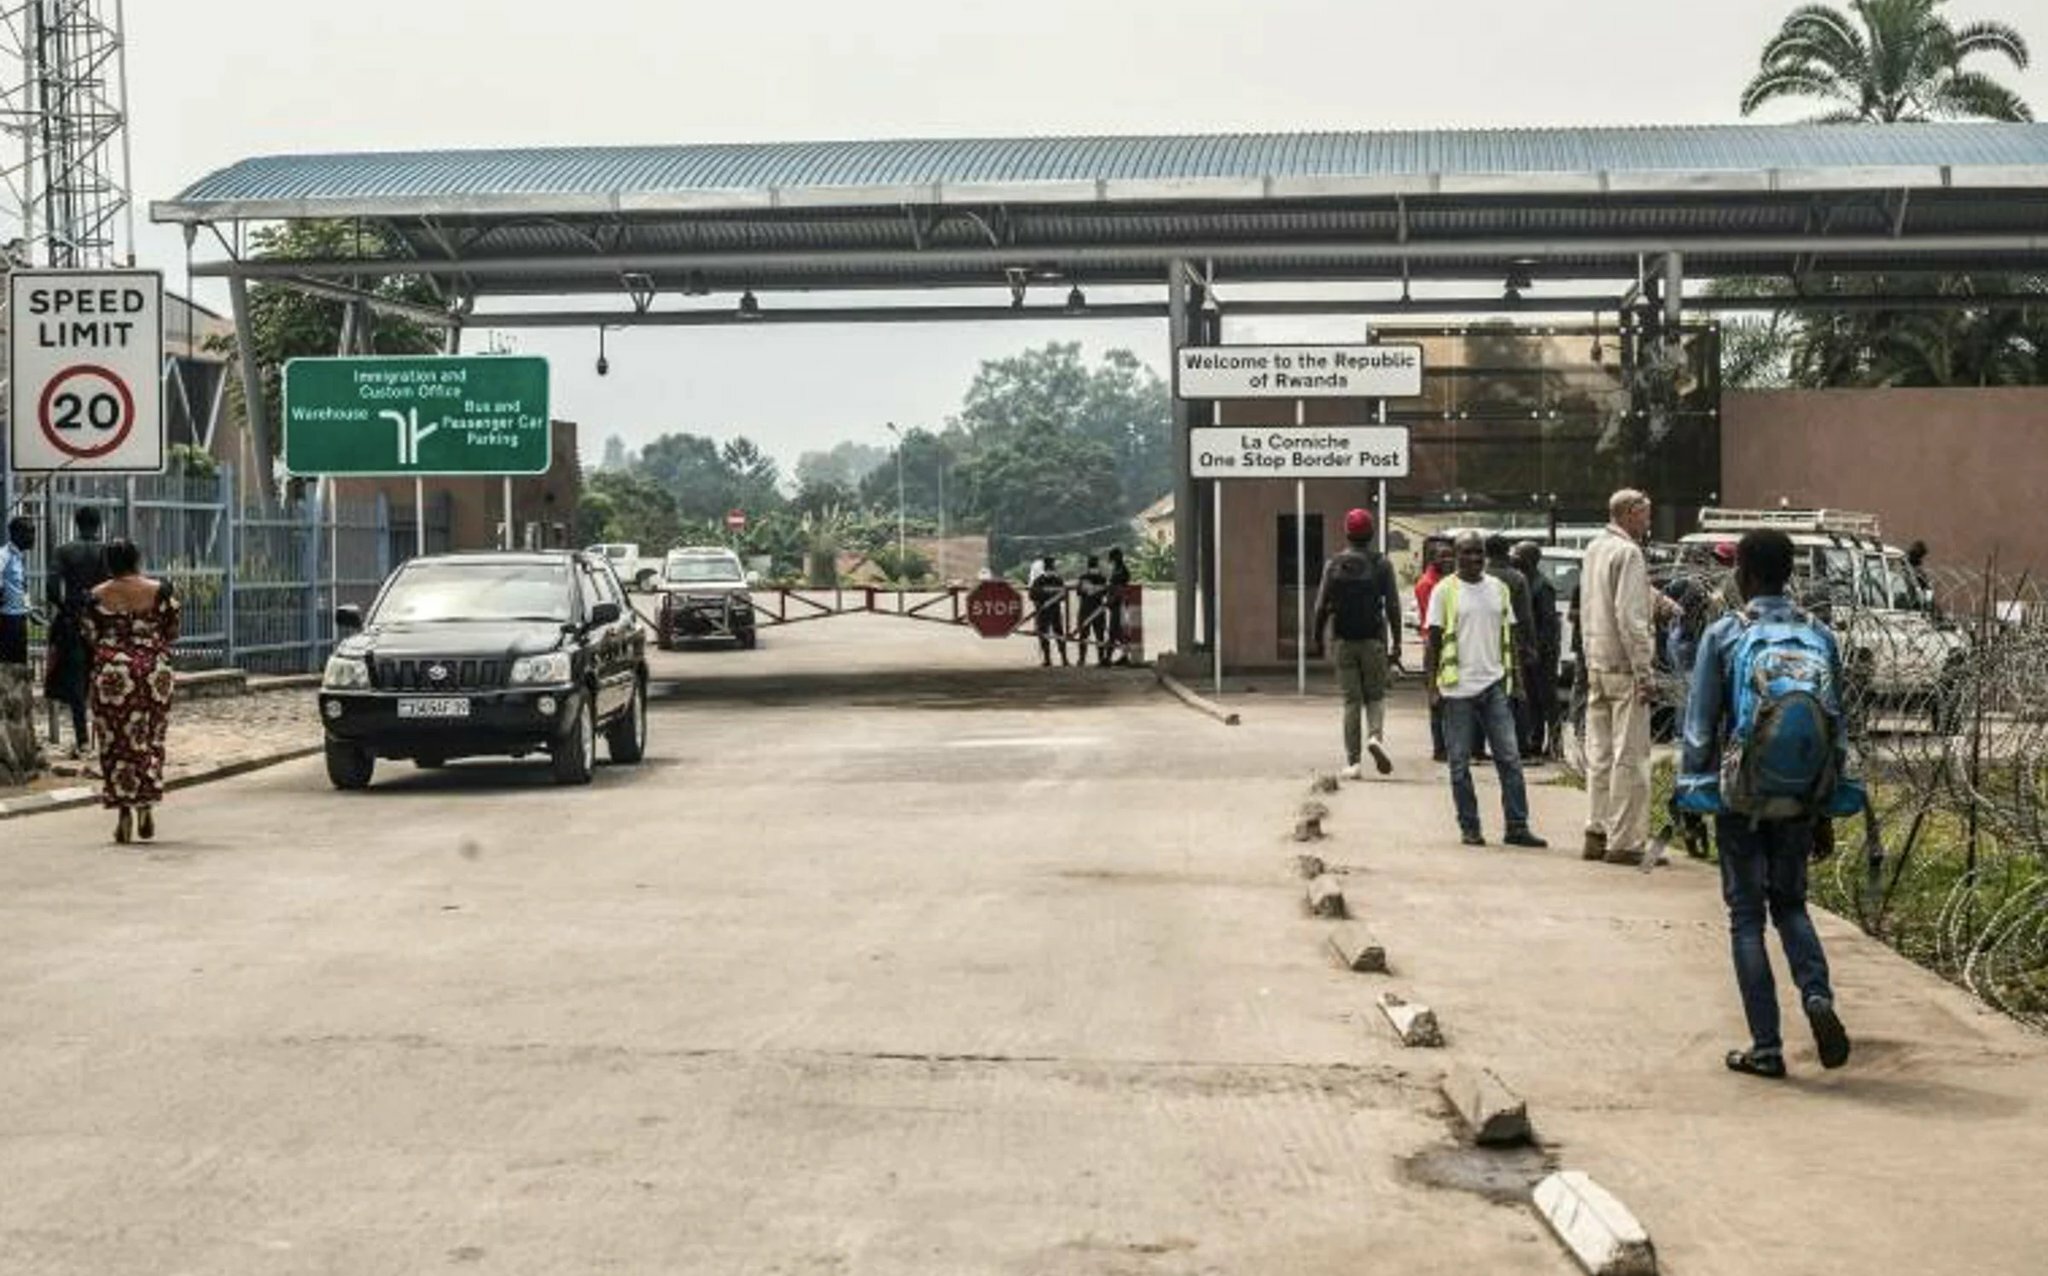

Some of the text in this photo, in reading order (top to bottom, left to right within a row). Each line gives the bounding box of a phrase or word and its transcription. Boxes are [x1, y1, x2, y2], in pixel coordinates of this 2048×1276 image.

[29, 289, 144, 314] SPEED
[39, 321, 134, 347] LIMIT
[1185, 352, 1416, 372] Welcome to the Republic
[353, 368, 467, 384] Immigration and
[1249, 372, 1349, 388] of Rwanda
[359, 384, 462, 398] Custom Office
[53, 392, 120, 430] 20
[291, 406, 369, 421] Warehouse
[464, 399, 521, 412] Bus and
[442, 416, 543, 432] Passenger Car
[467, 432, 519, 447] Parking
[1241, 432, 1350, 449] La Corniche
[1199, 450, 1400, 470] One Stop Border Post
[971, 600, 1019, 616] STOP
